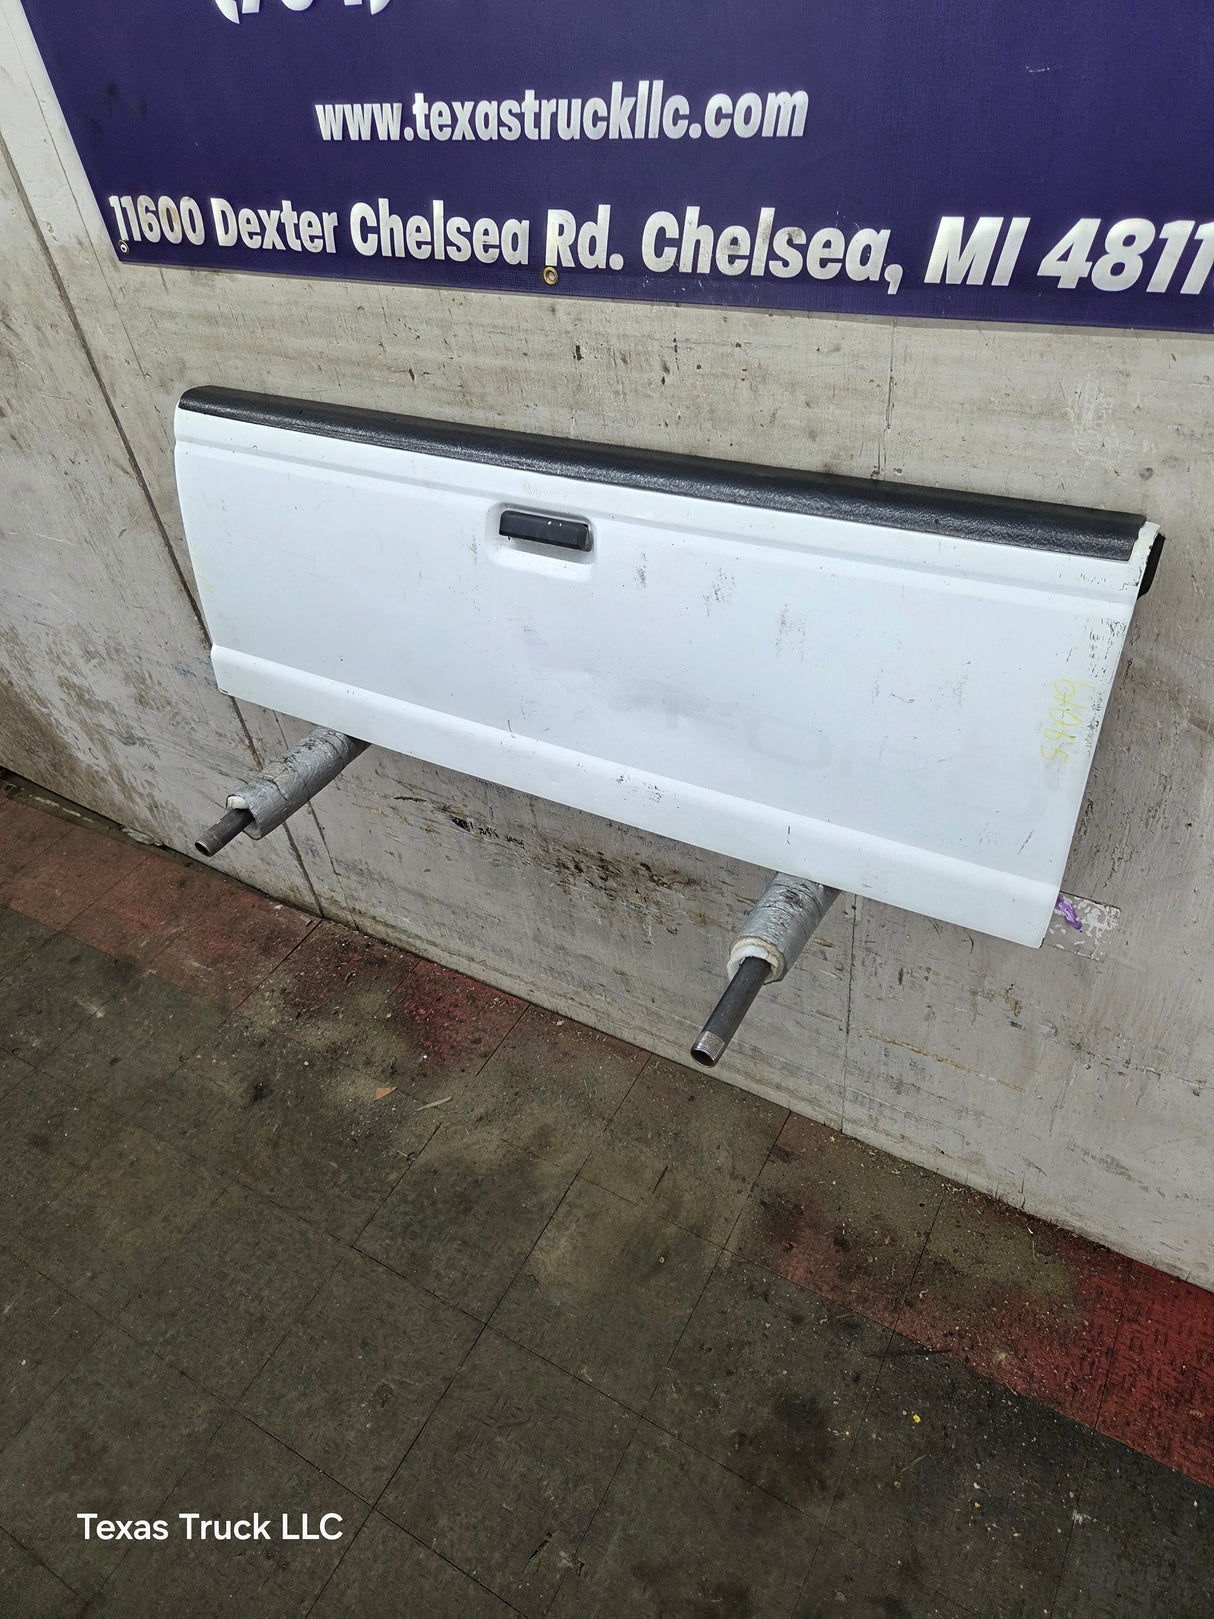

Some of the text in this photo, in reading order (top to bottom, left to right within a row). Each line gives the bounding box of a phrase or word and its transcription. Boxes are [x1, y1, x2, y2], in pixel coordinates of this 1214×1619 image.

[315, 79, 809, 142] www.texastruckllc.com
[108, 195, 206, 246] 11600
[210, 197, 339, 254] Dexter
[350, 200, 530, 266] Chelsea
[544, 203, 624, 272] Rd.
[641, 205, 904, 295] Chelsea,
[923, 215, 1031, 288] MI
